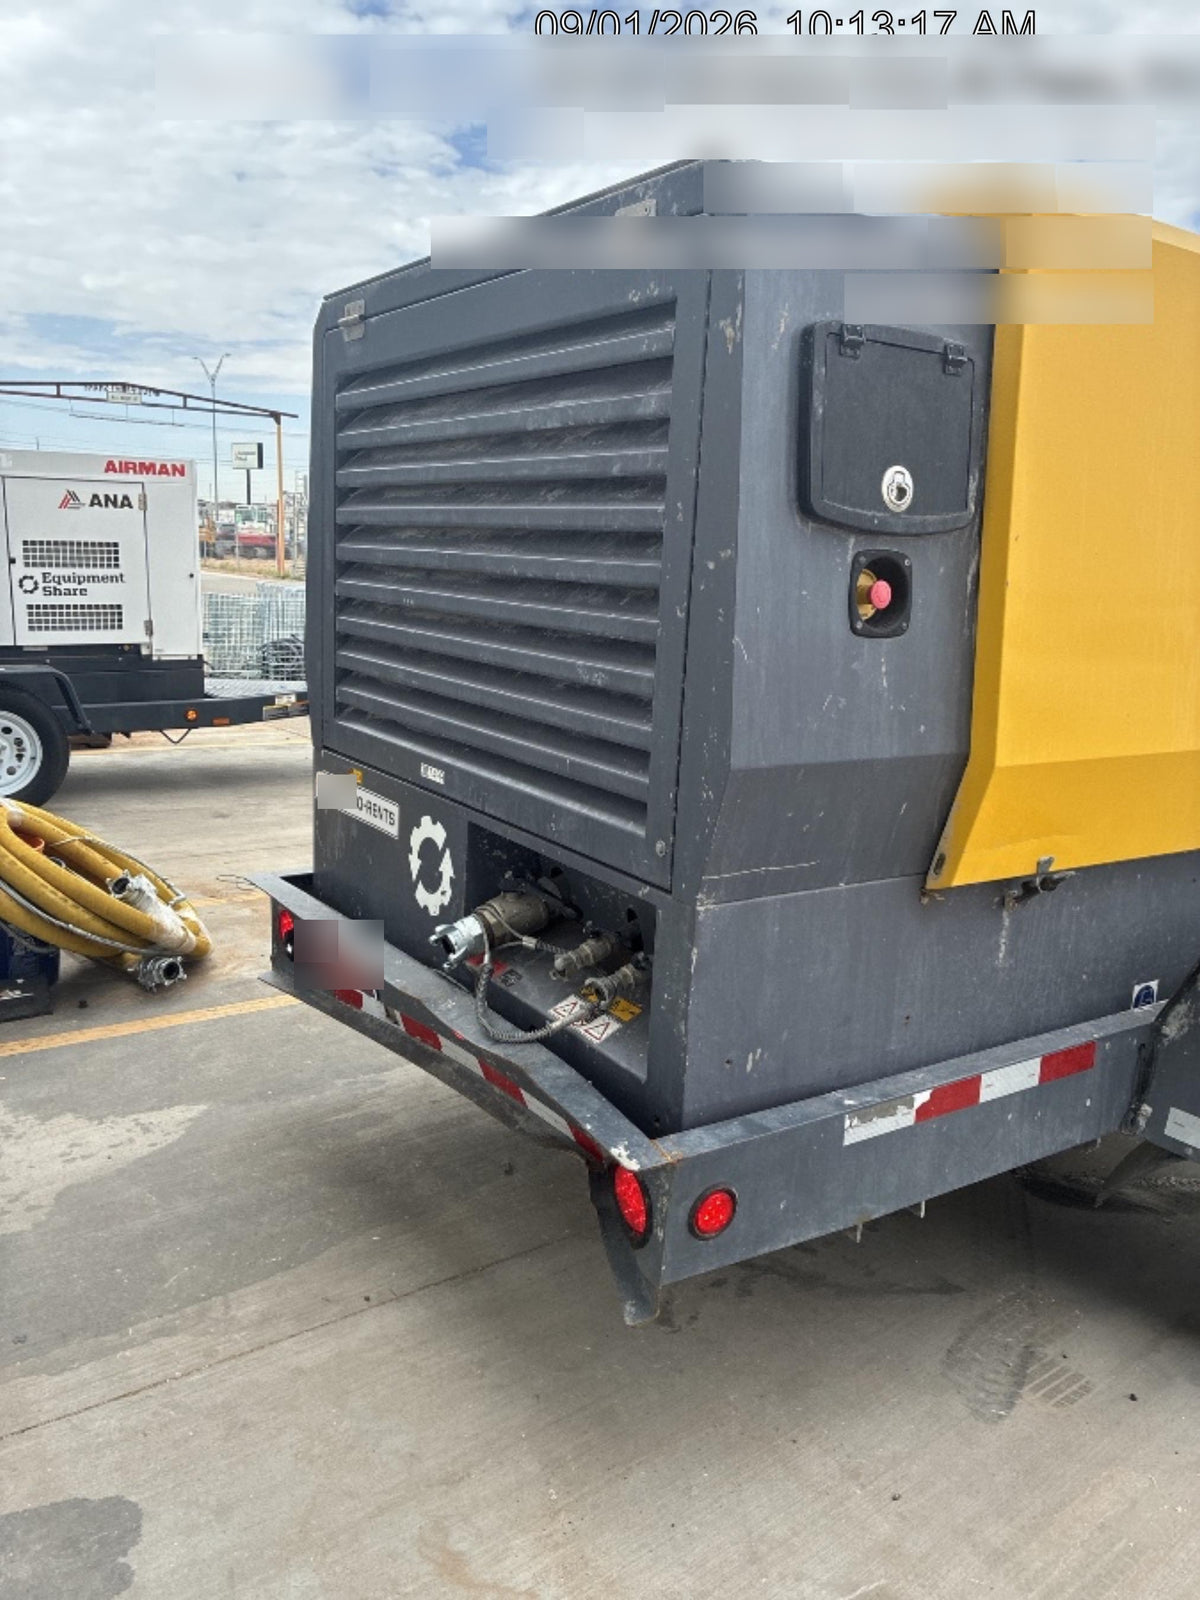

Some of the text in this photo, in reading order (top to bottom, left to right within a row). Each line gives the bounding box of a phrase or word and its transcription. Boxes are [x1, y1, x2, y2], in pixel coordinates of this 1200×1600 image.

[104, 459, 186, 477] AIRMAN
[89, 493, 133, 509] ANA
[42, 573, 125, 585] Equipment
[42, 586, 88, 597] Share
